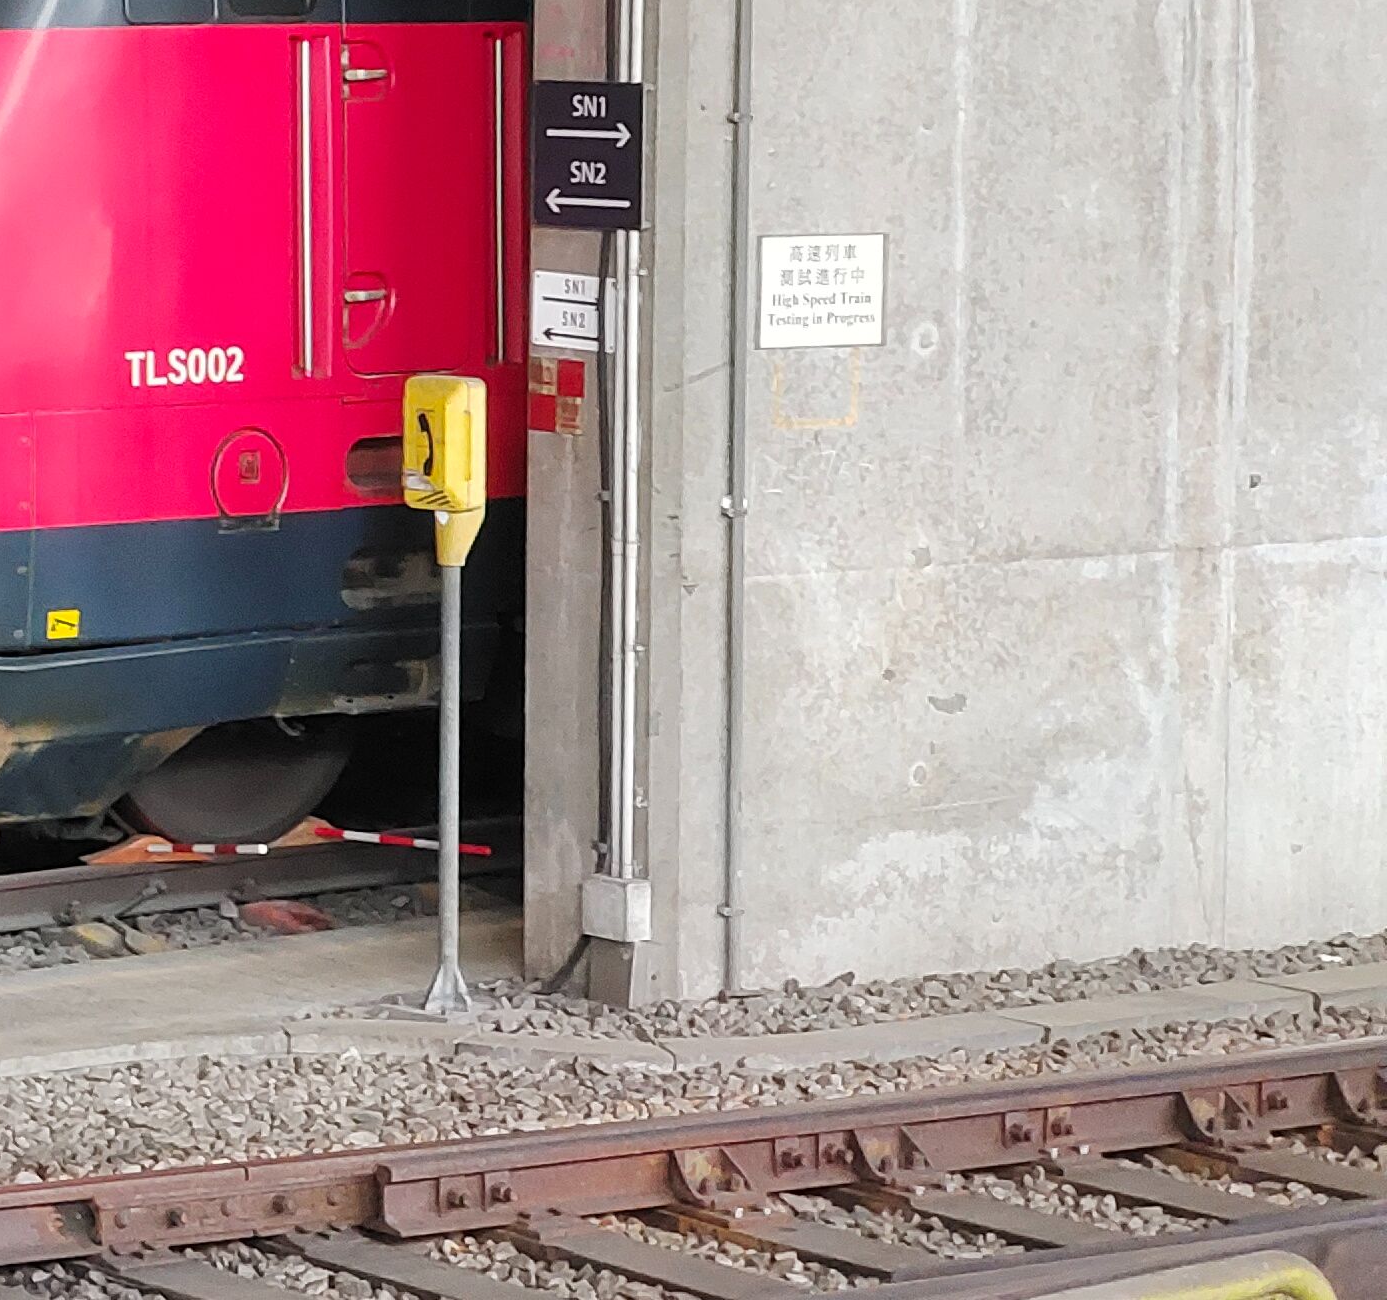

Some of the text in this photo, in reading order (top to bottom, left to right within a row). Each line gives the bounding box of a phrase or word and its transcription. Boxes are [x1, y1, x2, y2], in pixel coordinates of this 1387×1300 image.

[572, 94, 607, 118] SN1
[570, 161, 607, 185] SN2
[564, 278, 586, 296] SN1
[772, 292, 872, 308] High Speed Train
[561, 310, 586, 329] SN2
[767, 312, 875, 328] Testing in Progress
[124, 346, 245, 387] TLS002
